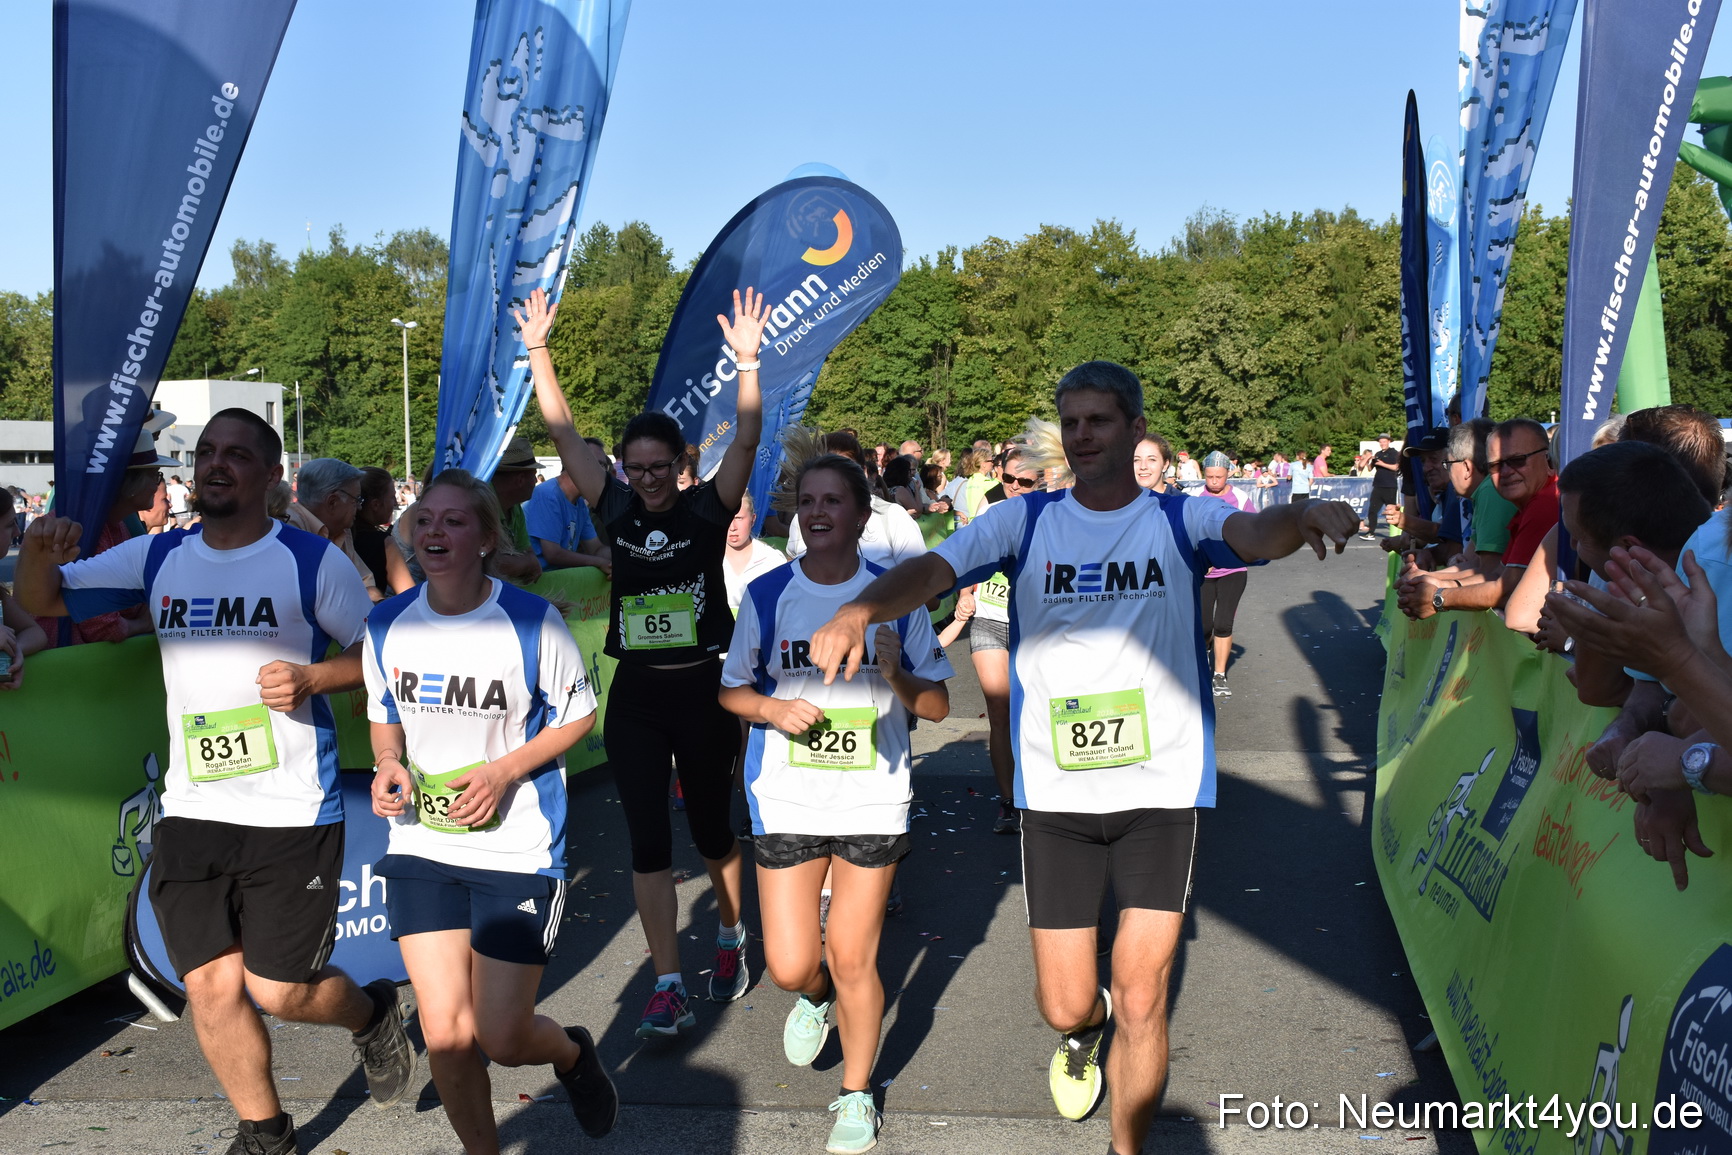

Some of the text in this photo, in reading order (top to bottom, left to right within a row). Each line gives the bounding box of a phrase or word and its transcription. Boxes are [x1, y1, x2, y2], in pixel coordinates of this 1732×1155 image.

[86, 81, 240, 475] www.fischer-automobile.de
[774, 251, 888, 357] Druck und Medien
[1042, 589, 1167, 605] eading FILTER Technology
[644, 613, 672, 634] 65
[160, 628, 279, 639] eading FILTER Technology
[420, 705, 455, 715] FILTER
[458, 708, 508, 721] Technology
[807, 729, 857, 754] 826
[1070, 717, 1125, 749] 827
[199, 731, 249, 762] 831
[1069, 743, 1135, 758] Ramsauer Roland
[205, 756, 252, 770] Rogall Stefan
[810, 752, 855, 761] Hiller Jessica
